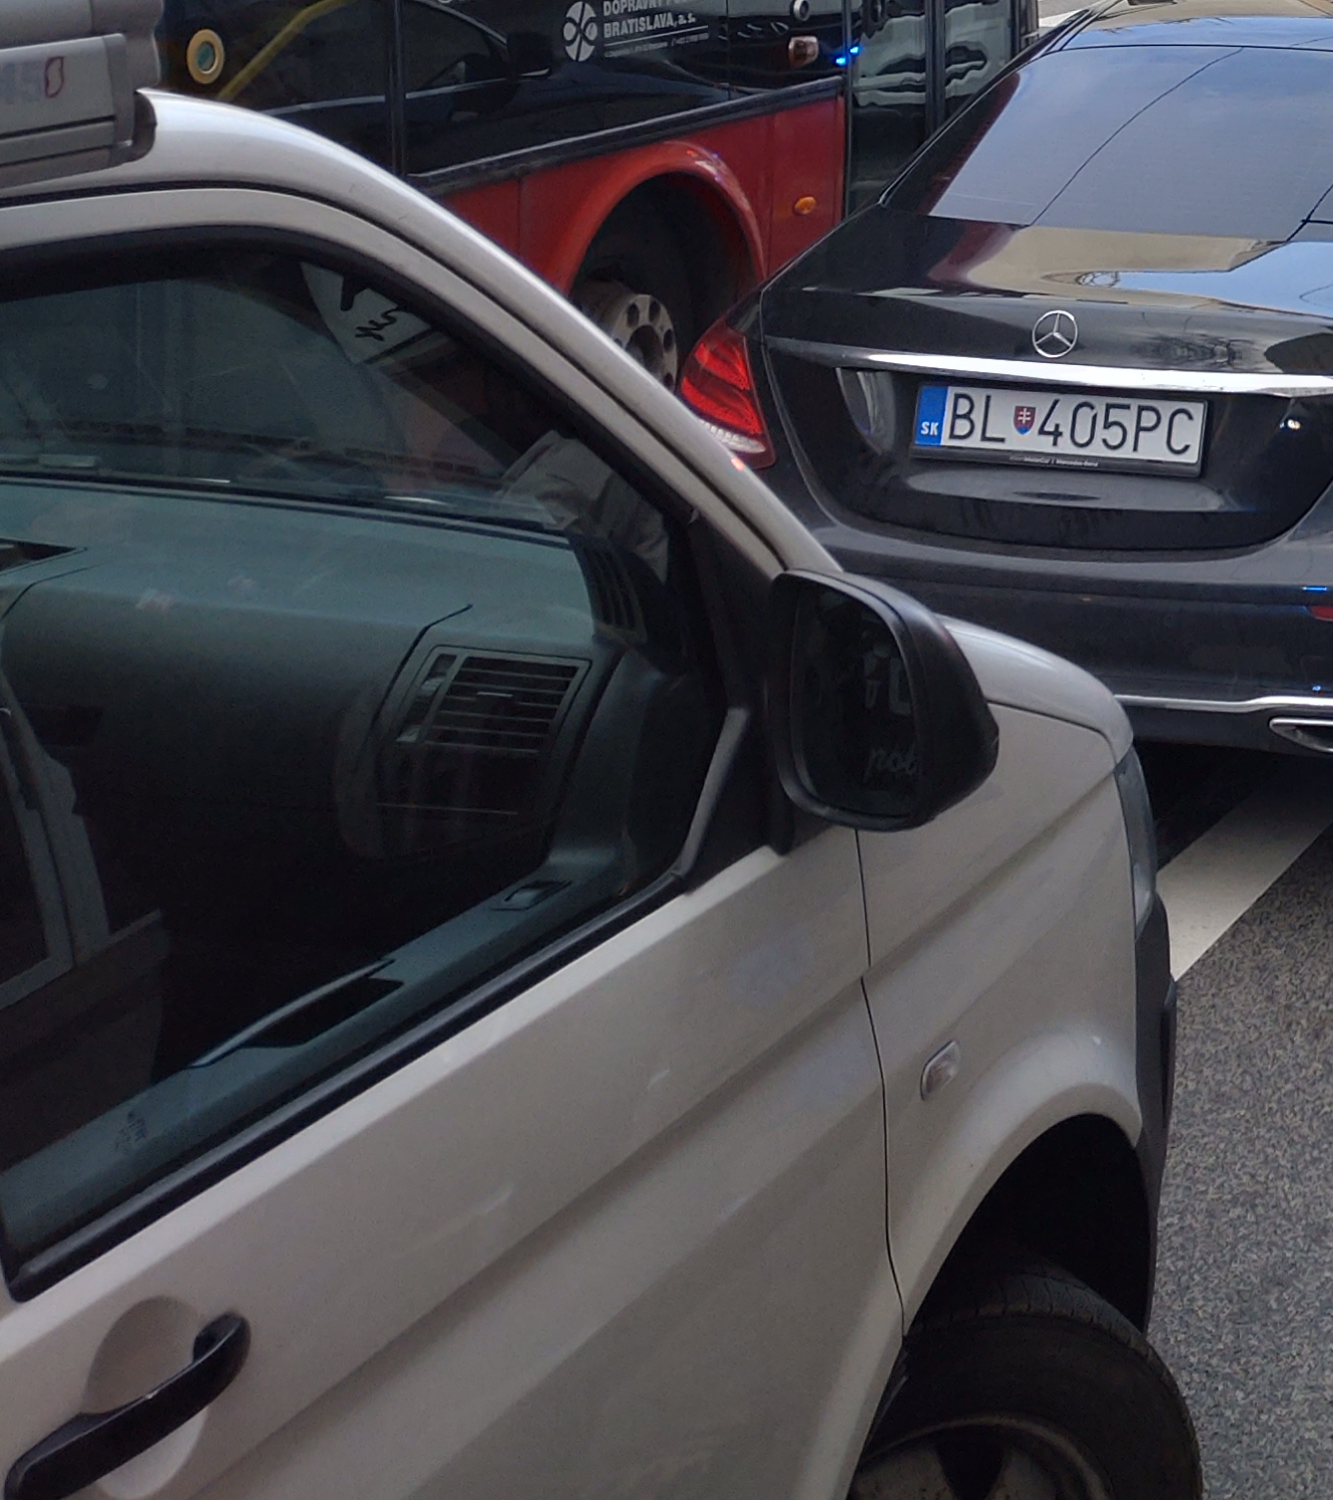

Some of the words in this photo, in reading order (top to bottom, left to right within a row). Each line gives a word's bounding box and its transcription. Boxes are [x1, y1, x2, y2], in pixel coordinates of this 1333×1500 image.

[920, 419, 939, 437] SK
[948, 393, 1006, 443] BL
[1037, 398, 1195, 457] 405PC
